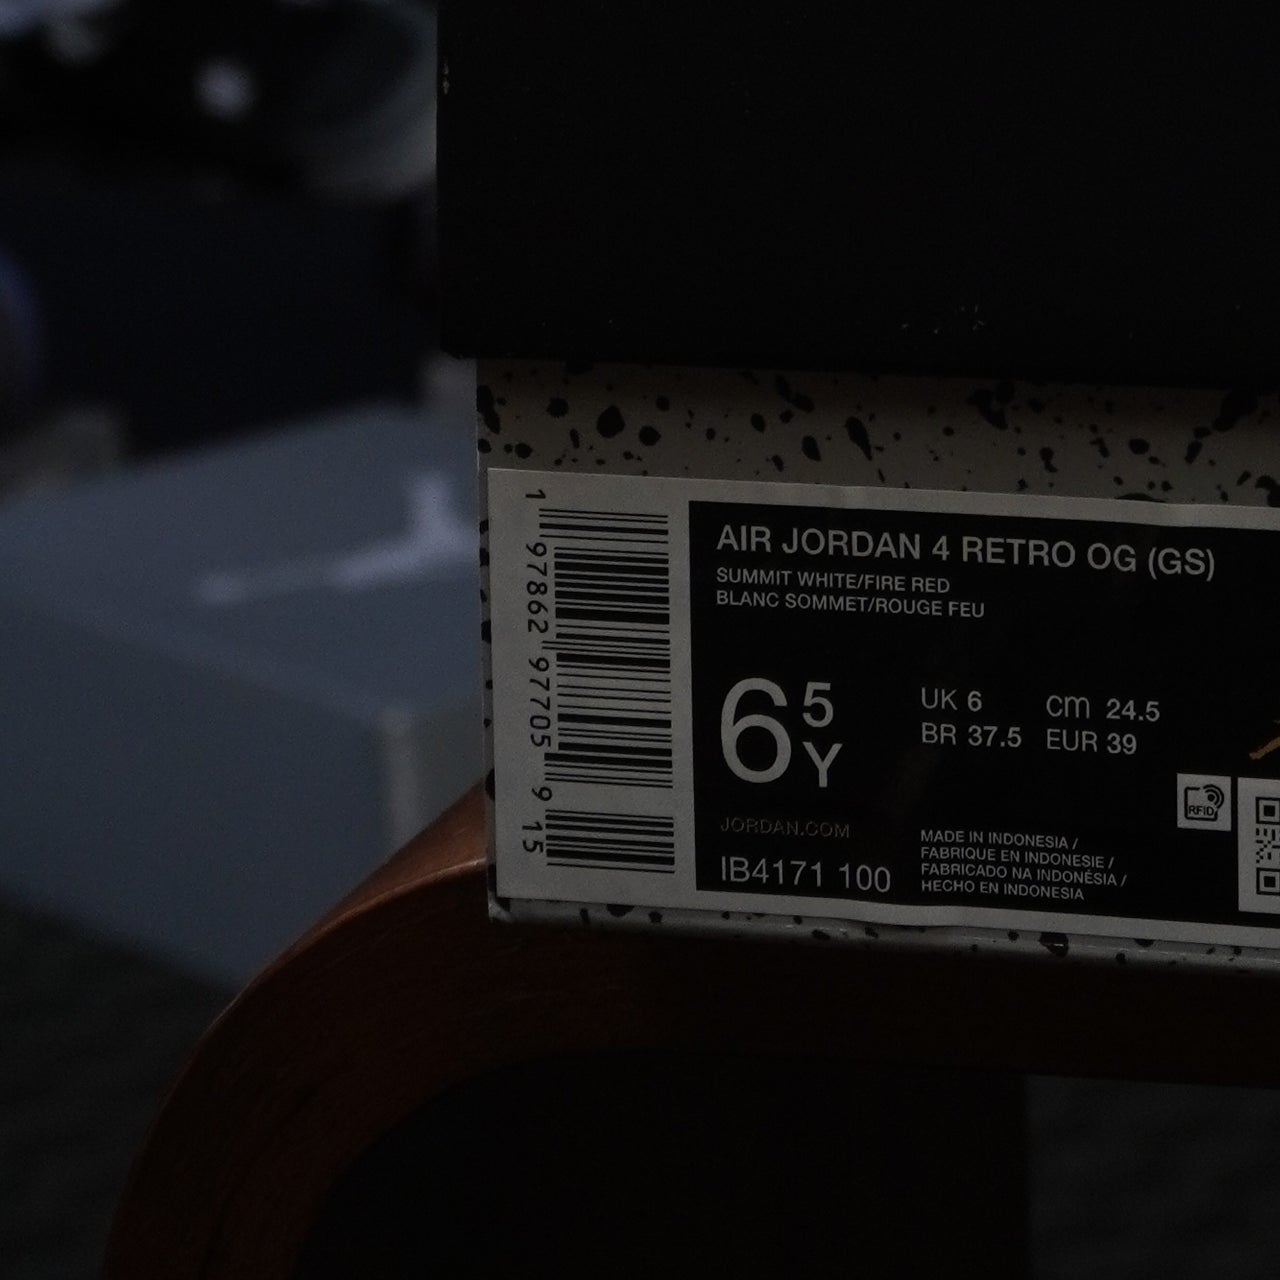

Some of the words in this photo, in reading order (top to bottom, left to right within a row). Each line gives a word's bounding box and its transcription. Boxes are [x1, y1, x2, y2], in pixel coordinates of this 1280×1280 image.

[716, 524, 772, 553] AIR
[781, 527, 921, 560] JORDAN
[931, 535, 950, 561] 4
[961, 536, 1076, 568] RETRO
[1087, 542, 1137, 573] OG
[1148, 546, 1215, 582] (GS)
[526, 542, 548, 635] 97862
[716, 567, 792, 586] SUMMIT
[798, 571, 906, 592] WHITE/FIRE
[911, 577, 950, 594] RED
[716, 590, 780, 608] BLANC
[785, 593, 943, 617] SOMMET/ROUGE
[948, 601, 985, 619] FEU
[528, 657, 551, 748] 97705
[921, 687, 957, 711] UK
[967, 690, 983, 713] 6
[1106, 698, 1160, 723] 24.5
[721, 677, 792, 784] 6
[921, 721, 957, 746] BR
[967, 724, 1022, 749] 37.5
[1046, 727, 1098, 754] EUR
[1106, 732, 1137, 756] 39
[532, 786, 552, 802] 9
[1188, 805, 1214, 816] RFID
[522, 820, 545, 854] 15
[720, 816, 850, 839] JORDAN.COM
[920, 829, 965, 843] MADE
[969, 831, 984, 845] IN
[988, 832, 1070, 850] INDONESIA
[920, 846, 997, 862] FABRIQUE
[1000, 849, 1021, 863] EN
[1024, 851, 1104, 869] INDONESIE
[721, 855, 823, 888] IB4171
[838, 863, 892, 893] 100
[920, 863, 1008, 879] FABRICADO
[1012, 866, 1033, 880] NA
[921, 880, 976, 894] HECHO
[979, 882, 1000, 895] EN
[1003, 883, 1085, 900] INDONESIA
